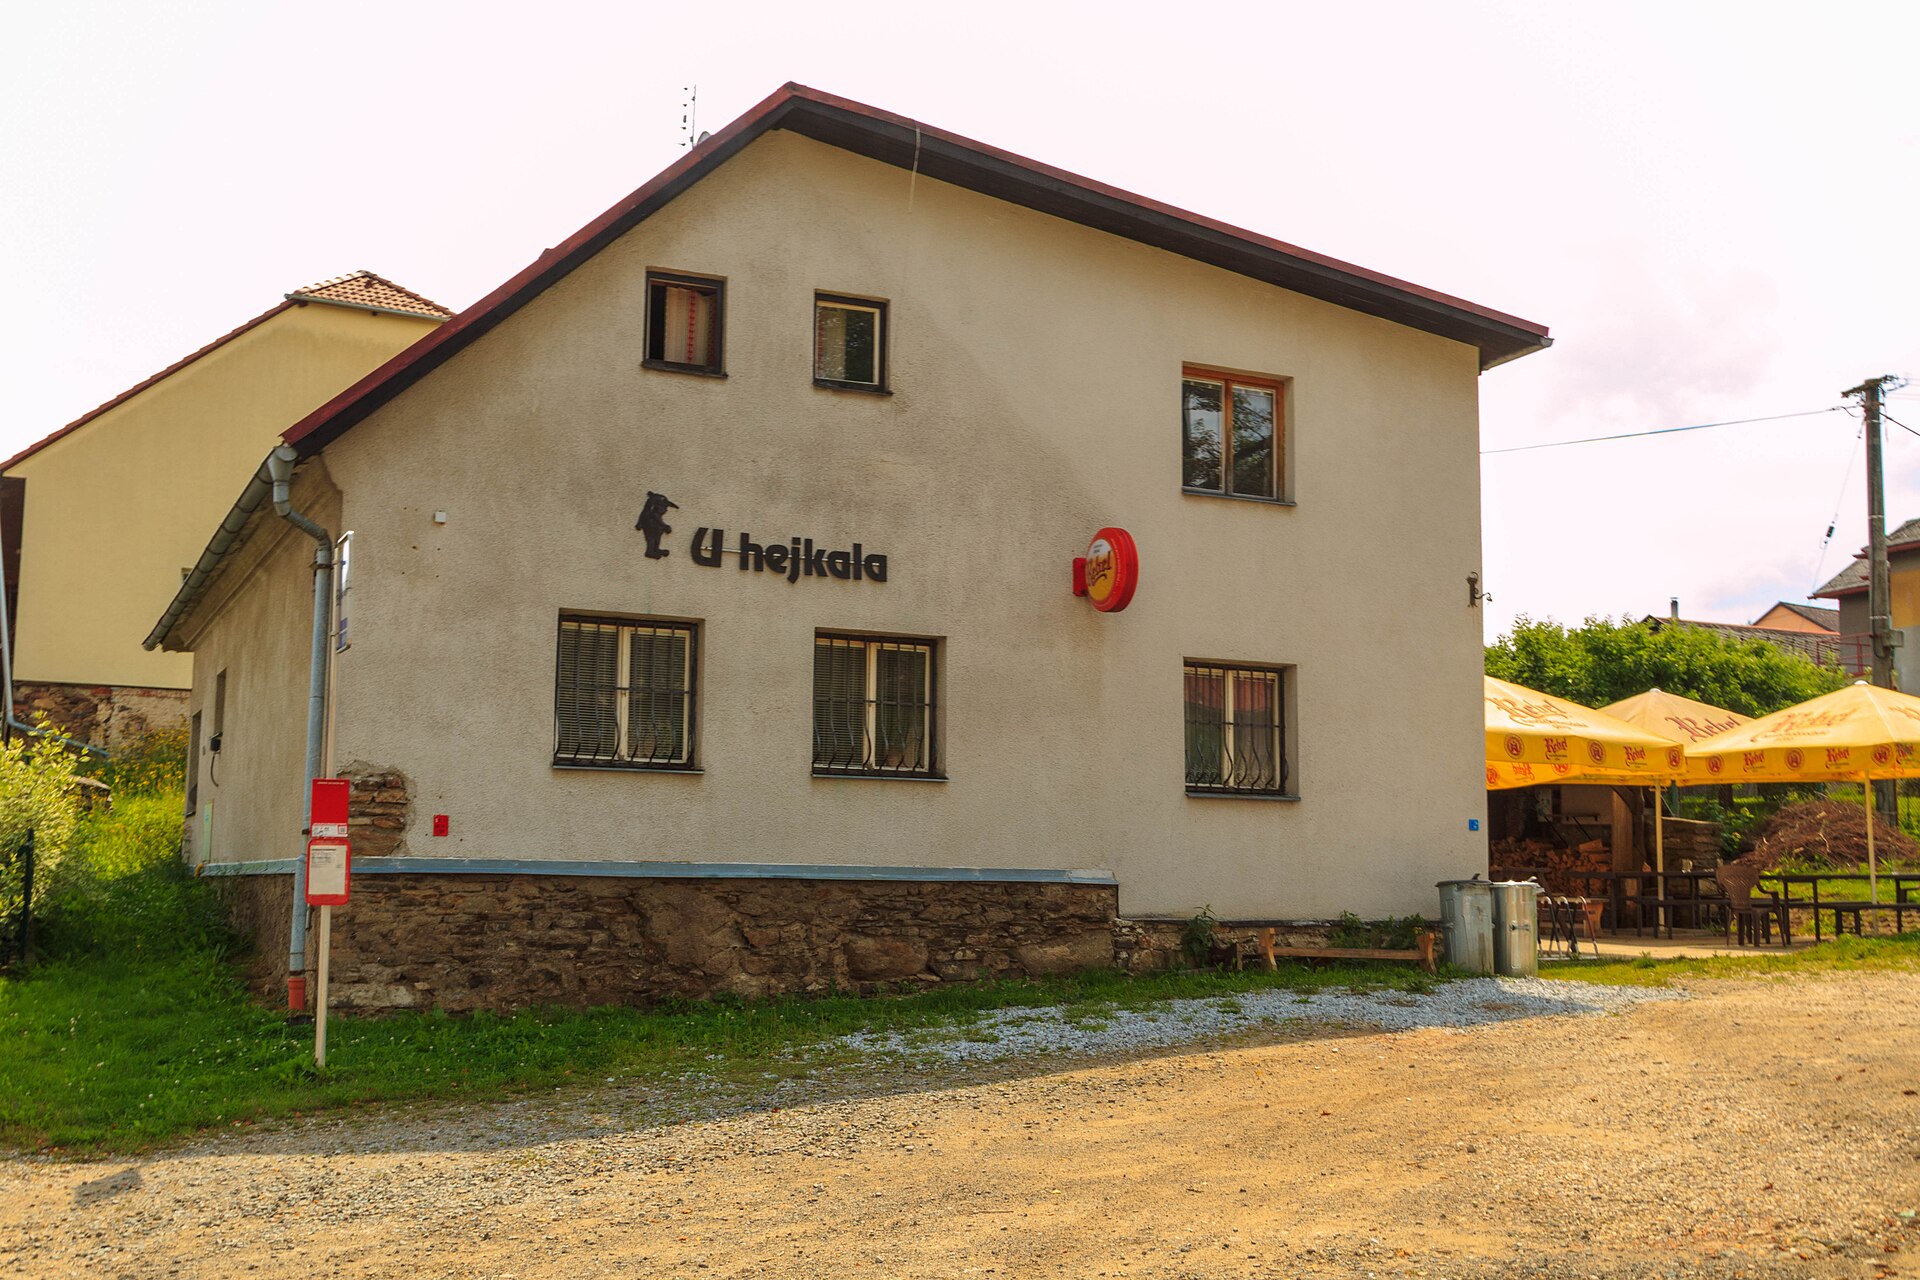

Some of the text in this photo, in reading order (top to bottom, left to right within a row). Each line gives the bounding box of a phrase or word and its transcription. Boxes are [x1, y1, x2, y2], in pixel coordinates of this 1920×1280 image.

[690, 527, 888, 585] U hejkala
[1486, 697, 1568, 722] Rebel
[1664, 713, 1741, 742] Rebel
[1545, 737, 1568, 757] Rebel
